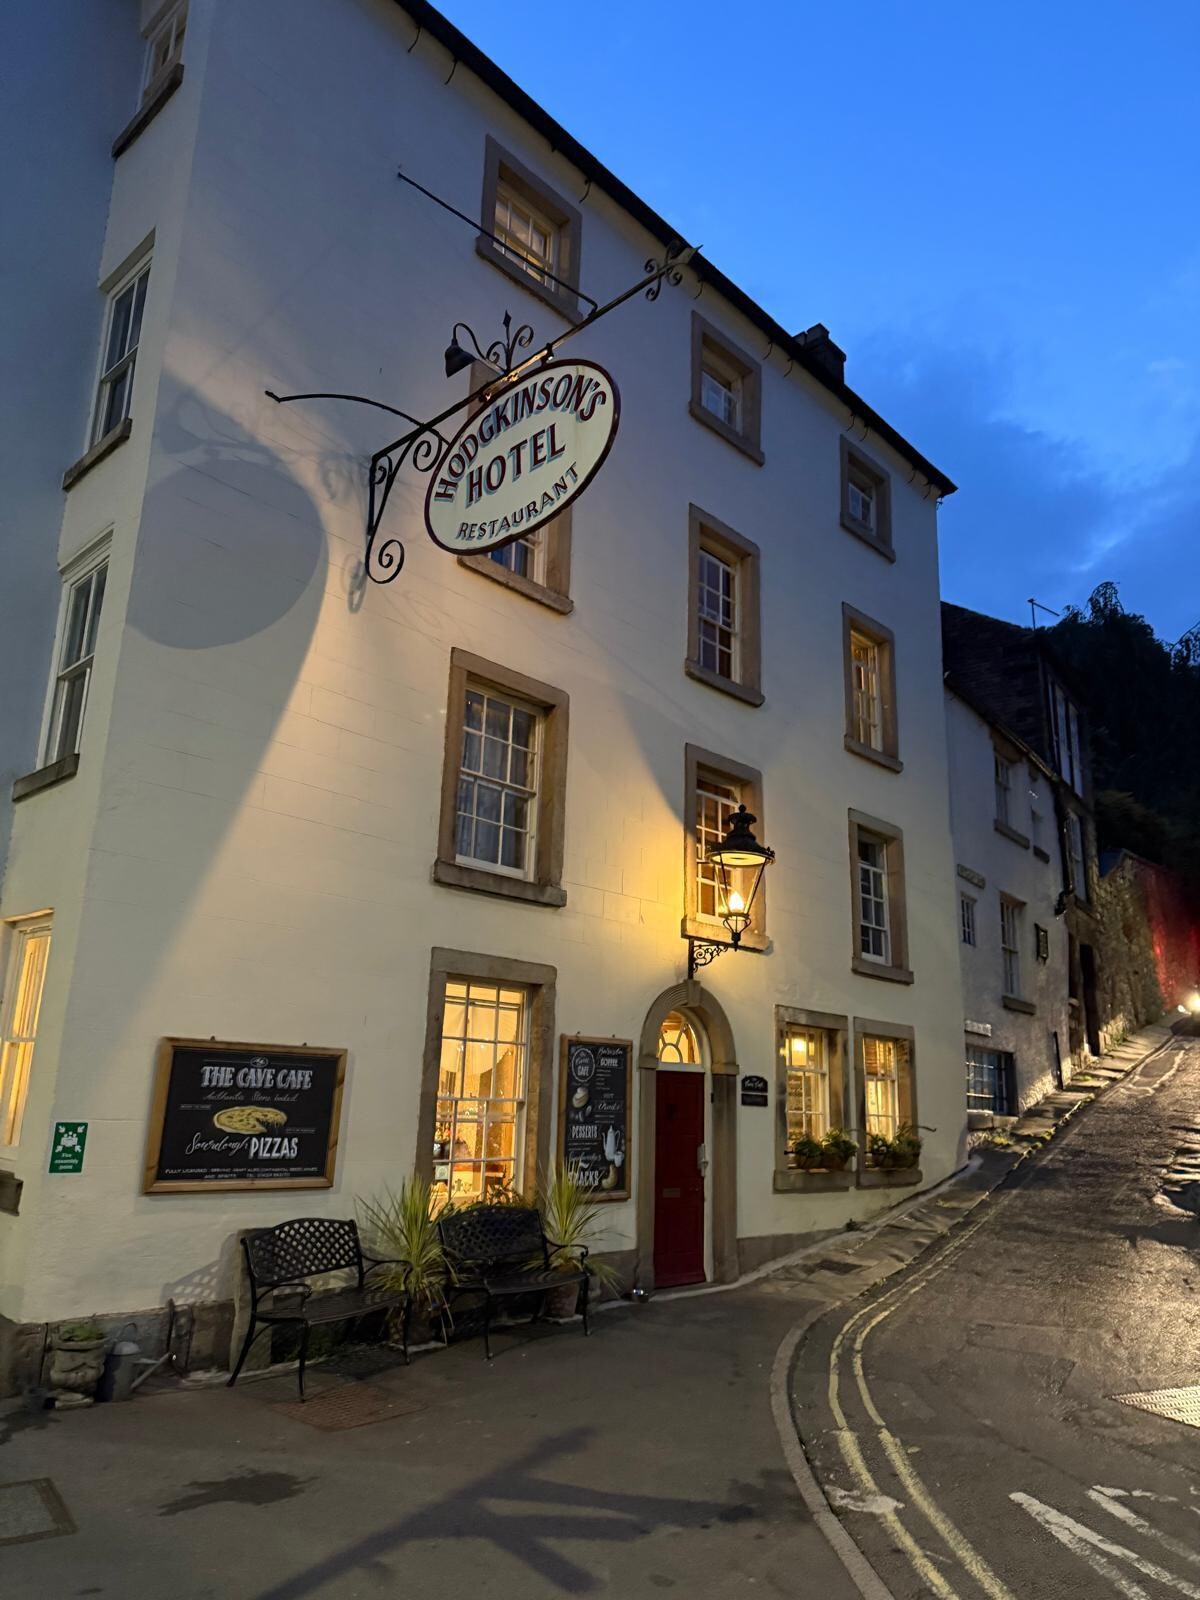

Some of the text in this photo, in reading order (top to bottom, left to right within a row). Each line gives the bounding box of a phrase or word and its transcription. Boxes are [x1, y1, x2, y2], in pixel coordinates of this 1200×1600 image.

[434, 373, 607, 503] HODGKINSON'S
[465, 423, 566, 508] HOTEL
[456, 461, 578, 541] RESTAURANT
[201, 1066, 313, 1090] THE CAVE CAFE
[185, 1132, 299, 1160] Sourdough PIZZAS
[571, 1124, 598, 1139] DESSERTS
